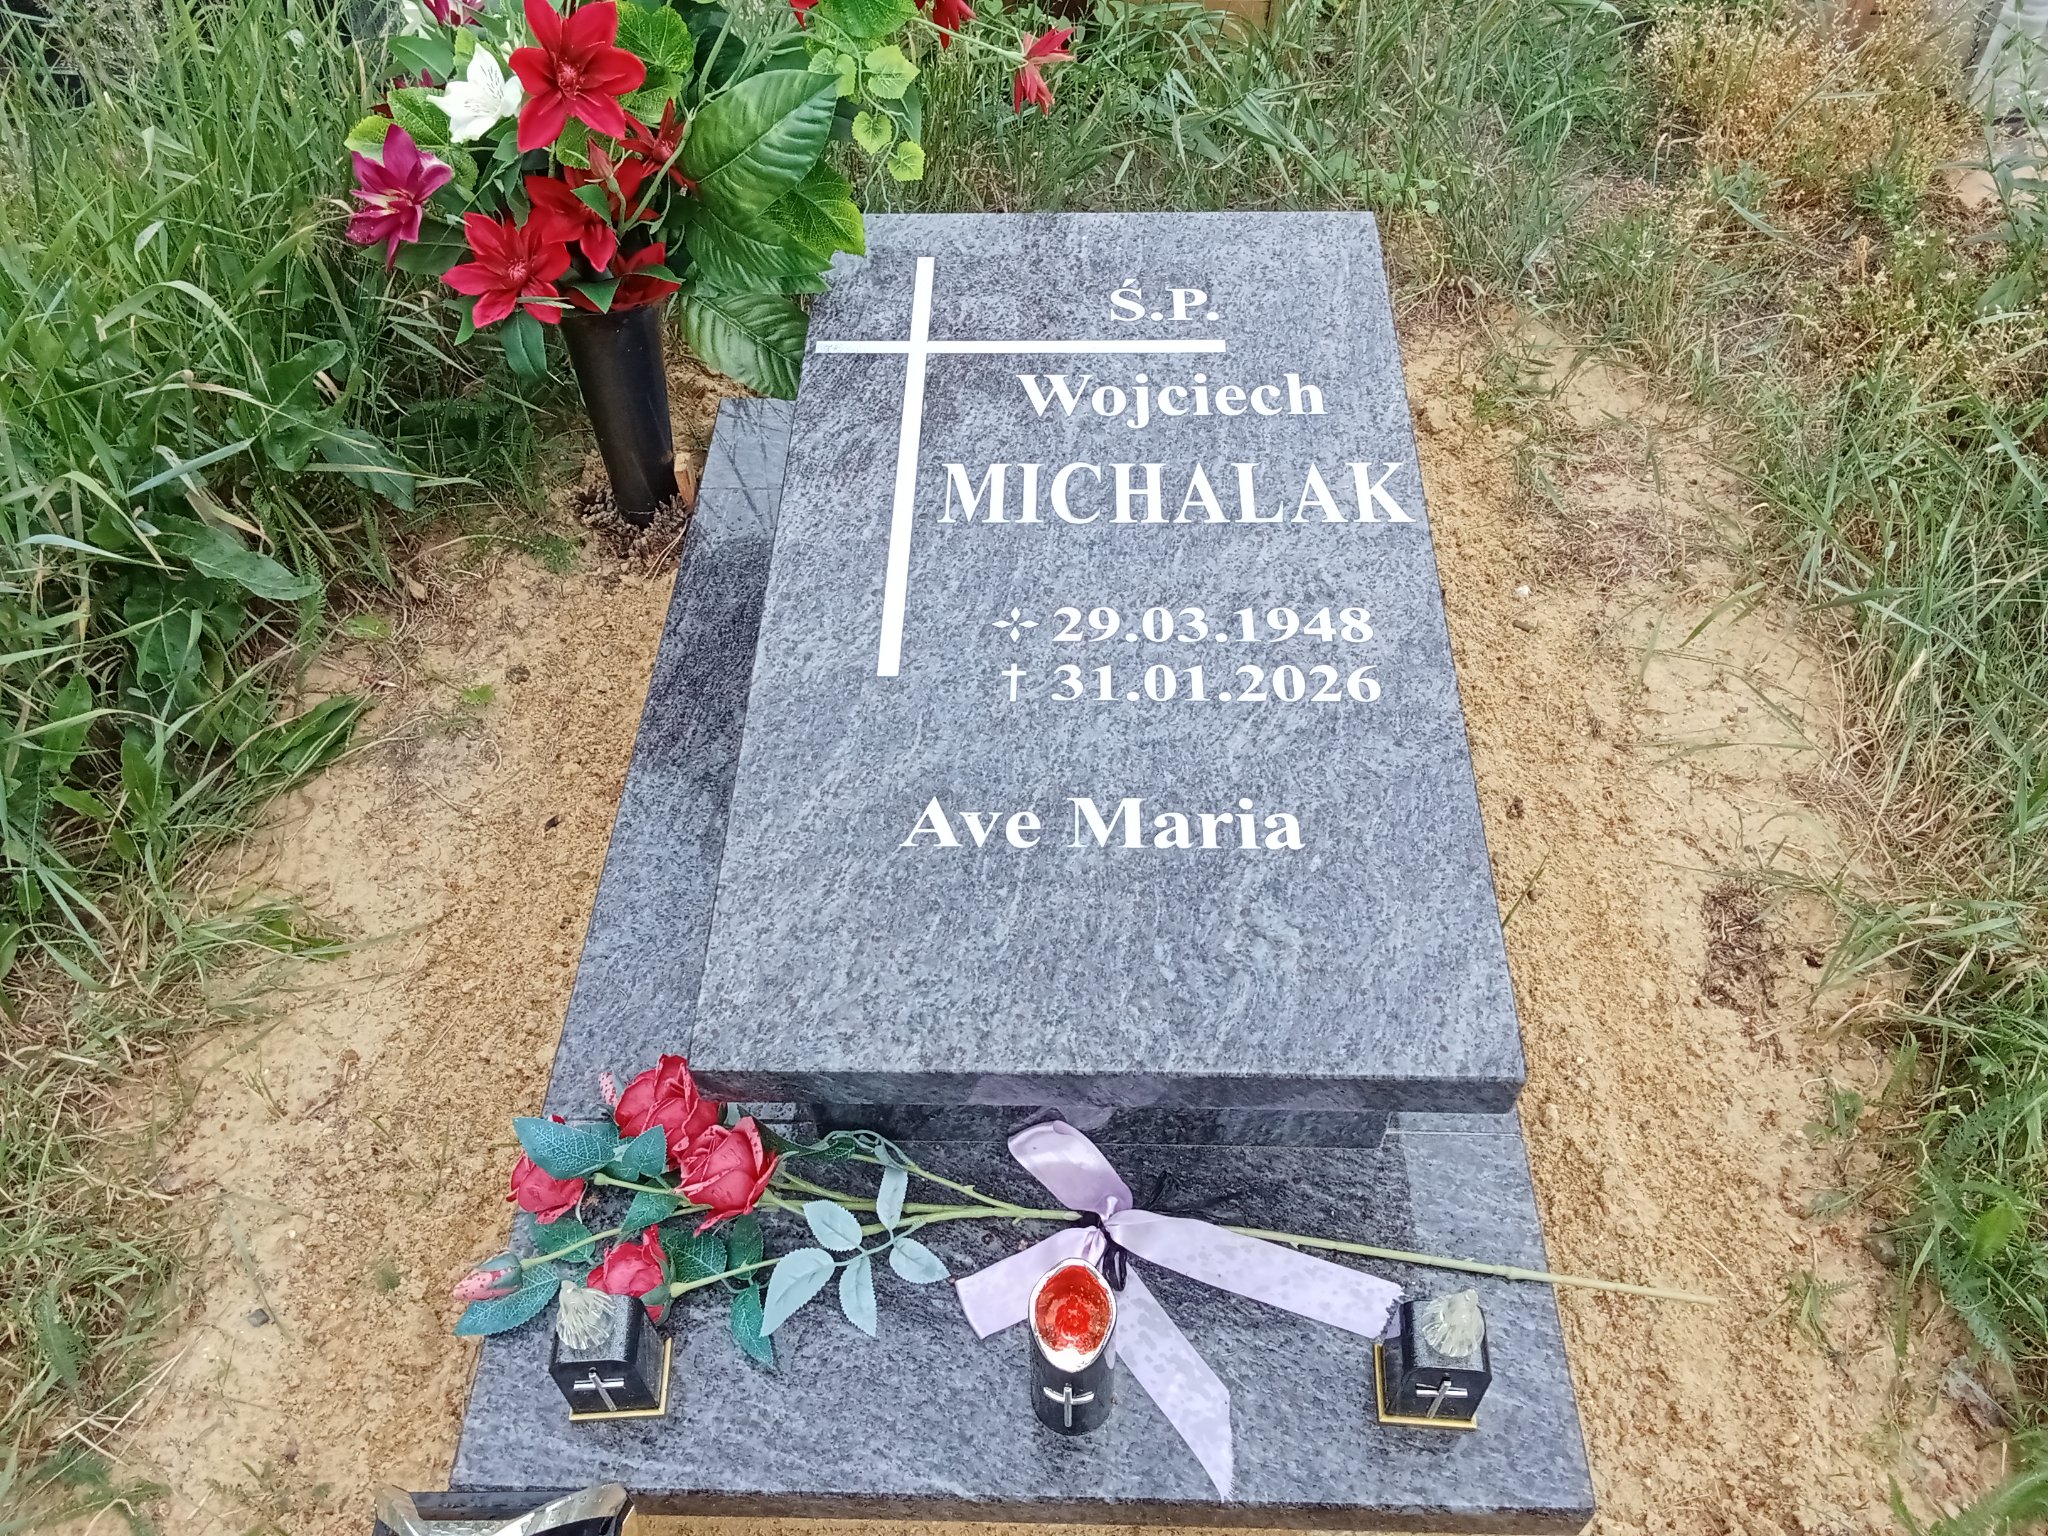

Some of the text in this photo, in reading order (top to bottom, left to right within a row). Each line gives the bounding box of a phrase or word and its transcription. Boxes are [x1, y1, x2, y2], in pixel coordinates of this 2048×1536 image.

[1109, 277, 1220, 322] Ś.P.
[1015, 372, 1328, 429] Wojciech
[936, 460, 1417, 525] MICHALAK
[1051, 605, 1374, 643] 29.03.1948
[1050, 664, 1381, 703] 31.01.2026
[898, 796, 1306, 850] Ave Maria
